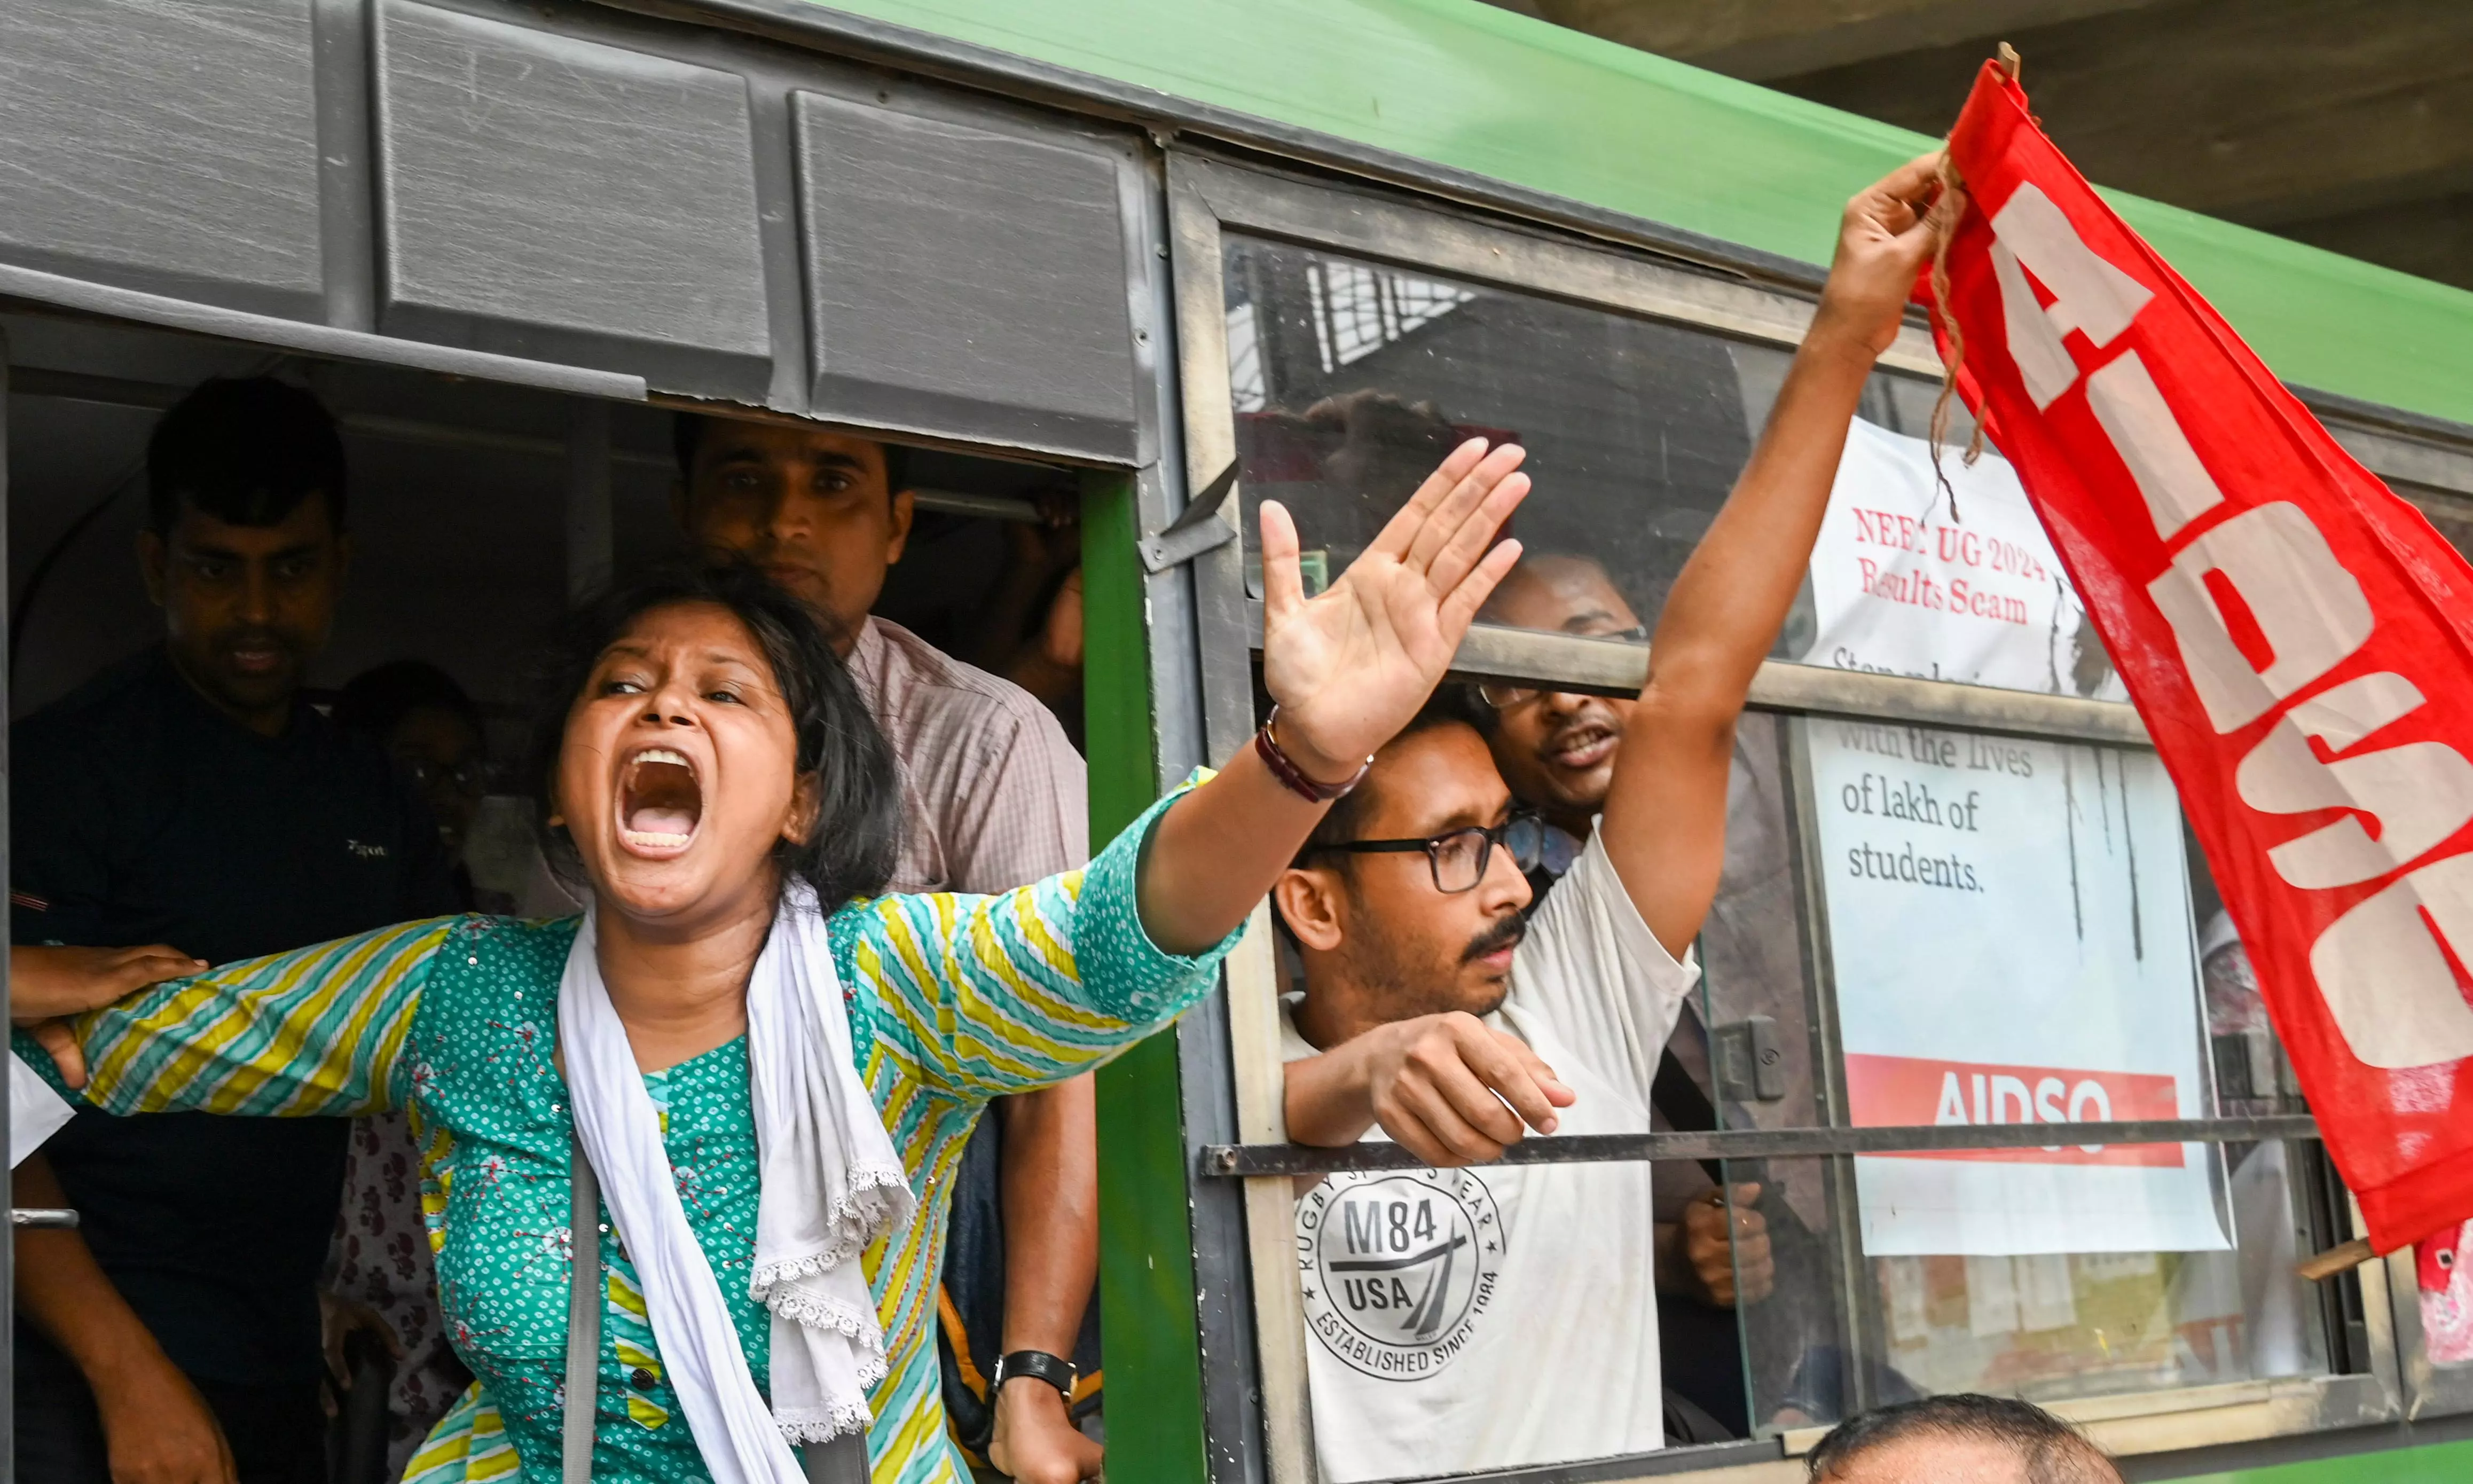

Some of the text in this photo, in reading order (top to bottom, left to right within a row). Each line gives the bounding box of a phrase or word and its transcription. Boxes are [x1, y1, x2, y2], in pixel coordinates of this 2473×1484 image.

[1938, 527, 1982, 567] UG
[1988, 537, 2046, 582] 2024
[1950, 577, 2028, 625] Scam
[1989, 180, 2473, 1068] AIDSO
[1905, 724, 1957, 768] the
[1967, 732, 2034, 779] lives
[1842, 772, 1980, 831] of lakh of
[1848, 841, 1985, 893] students.
[1933, 1071, 2113, 1153] AIDSO
[1298, 1168, 1493, 1271] RUGBY EAR
[1344, 1198, 1436, 1254] M84
[1344, 1277, 1414, 1312] USA
[1316, 1310, 1428, 1372] ESTABLISHED
